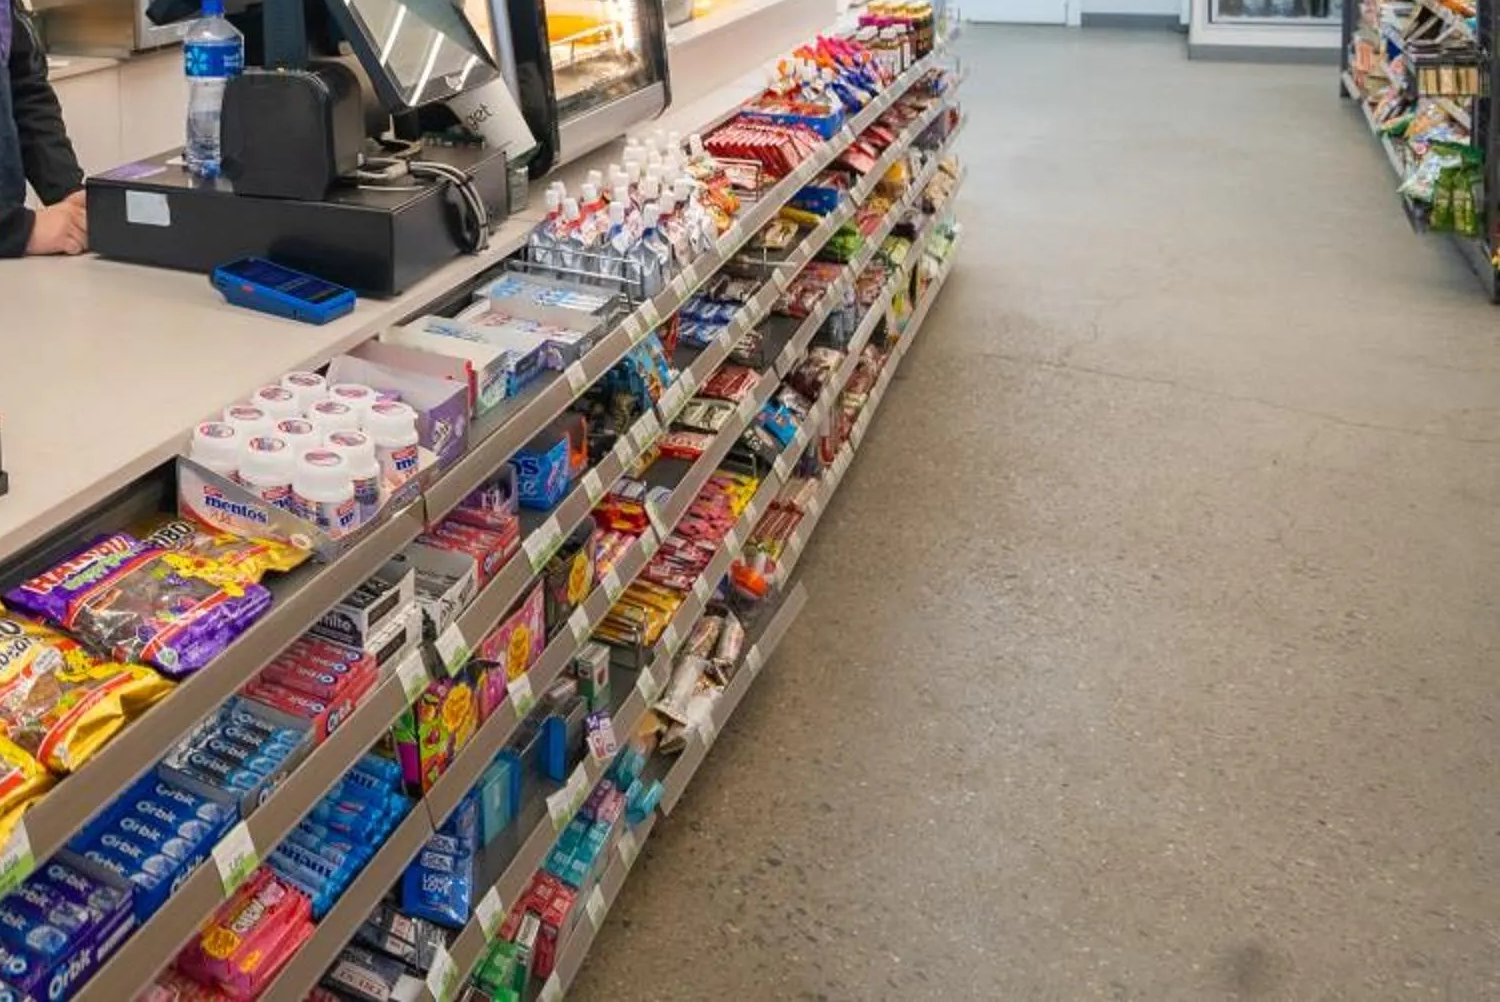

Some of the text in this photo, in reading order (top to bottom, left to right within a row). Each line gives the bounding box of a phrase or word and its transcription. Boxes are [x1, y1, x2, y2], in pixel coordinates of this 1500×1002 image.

[204, 495, 268, 524] mentos
[135, 800, 177, 823] Orbit
[119, 817, 161, 841] Orbit
[100, 834, 143, 858] Orbit
[49, 948, 92, 1000] Orbit
